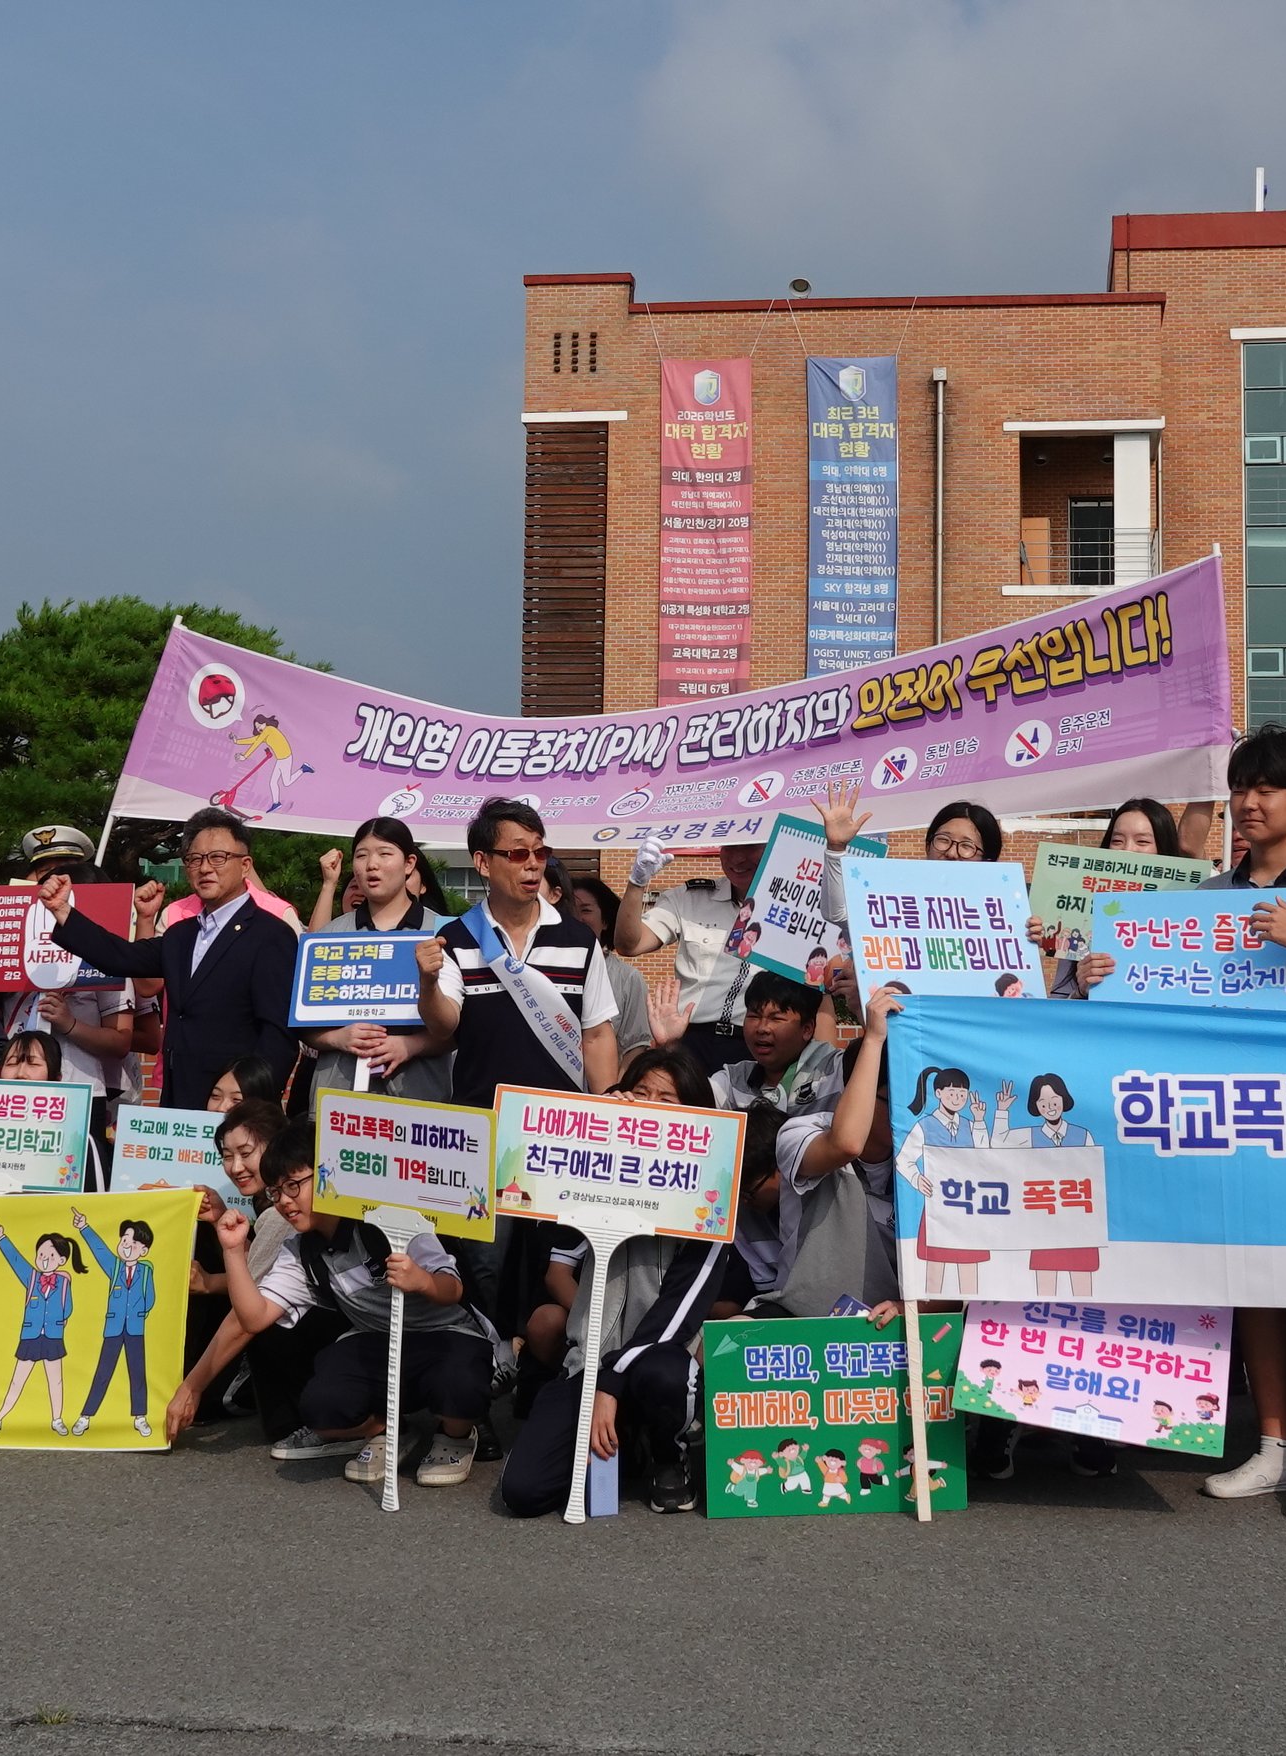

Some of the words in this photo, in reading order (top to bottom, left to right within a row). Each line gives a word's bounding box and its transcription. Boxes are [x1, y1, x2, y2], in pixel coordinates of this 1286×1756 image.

[678, 410, 735, 421] 2026학년도
[827, 406, 854, 420] 최근
[857, 406, 879, 419] 3년
[665, 423, 696, 440] 대학
[701, 422, 748, 440] 합격자
[813, 422, 844, 439] 대학
[848, 422, 895, 439] 합격자
[690, 443, 723, 459] 현황
[839, 441, 870, 458] 현황
[671, 471, 692, 482] 의대,
[695, 472, 723, 483] 한의대
[726, 471, 741, 482] 2명
[822, 465, 841, 477] 의대,
[844, 465, 870, 477] 약학대
[873, 466, 887, 477] 8명
[663, 517, 725, 529] 서울/인천/경기
[728, 517, 749, 528] 20명
[824, 583, 842, 593] SKY
[844, 583, 871, 595] 합격생
[874, 583, 889, 595] 8명
[661, 604, 684, 615] 이공계
[687, 604, 711, 616] 특성화
[713, 605, 736, 615] 대학교
[738, 604, 750, 614] 2명
[813, 601, 840, 611] 서울대
[858, 602, 884, 612] 고려대
[835, 613, 861, 624] 연세대
[864, 614, 877, 624] (4)
[672, 648, 720, 659] 교육대학교
[723, 648, 737, 659] 2명
[813, 649, 841, 659] DGIST,
[843, 650, 871, 660] UNIST,
[679, 683, 706, 694] 국립대
[710, 683, 730, 694] 67명
[1059, 709, 1111, 734] 음주운전
[347, 703, 461, 772] 개인형
[1056, 737, 1083, 755] 금지
[925, 745, 950, 761] 동반
[792, 769, 814, 783] 주행
[815, 766, 827, 779] 중
[920, 763, 946, 778] 금지
[1048, 853, 1078, 868] 친구를
[1082, 857, 1138, 875] 괴롭히거나
[1141, 866, 1186, 882] 따돌리는
[1190, 869, 1201, 884] 등
[867, 894, 920, 930] 친구를
[924, 897, 980, 931] 지키는
[987, 898, 1013, 933] 힘,
[1115, 917, 1203, 950] 장난은
[27, 950, 73, 964] 사라져!
[314, 945, 344, 961] 학교
[348, 943, 394, 960] 규칙을
[863, 936, 921, 970] 관심과
[925, 937, 1031, 970] 배려입니다.
[311, 965, 371, 982] 존중하고
[1125, 962, 1212, 994] 상처는
[32, 1096, 66, 1121] 우정
[130, 1119, 168, 1136] 학교에
[172, 1123, 198, 1138] 있는
[330, 1111, 407, 1142] 학교폭력의
[411, 1123, 478, 1153] 피해자는
[523, 1106, 610, 1142] 나에게는
[617, 1117, 659, 1148] 작은
[667, 1123, 711, 1154] 장난
[122, 1144, 173, 1162] 존중하고
[340, 1148, 387, 1177] 영원히
[394, 1156, 469, 1189] 기억합니다.
[527, 1143, 612, 1181] 친구에겐
[619, 1155, 641, 1183] 큰
[648, 1159, 698, 1190] 상처!
[940, 1179, 1011, 1215] 학교
[1023, 1178, 1093, 1215] 폭력
[1117, 1314, 1176, 1345] 위해
[980, 1318, 1009, 1346] 한
[1020, 1327, 1046, 1354] 번
[1059, 1336, 1084, 1361] 더
[1096, 1341, 1213, 1383] 생각하고
[745, 1346, 819, 1383] 멈춰요,
[1046, 1363, 1140, 1402] 말해요!
[713, 1391, 818, 1429] 함께해요,
[824, 1389, 898, 1424] 따뜻한
